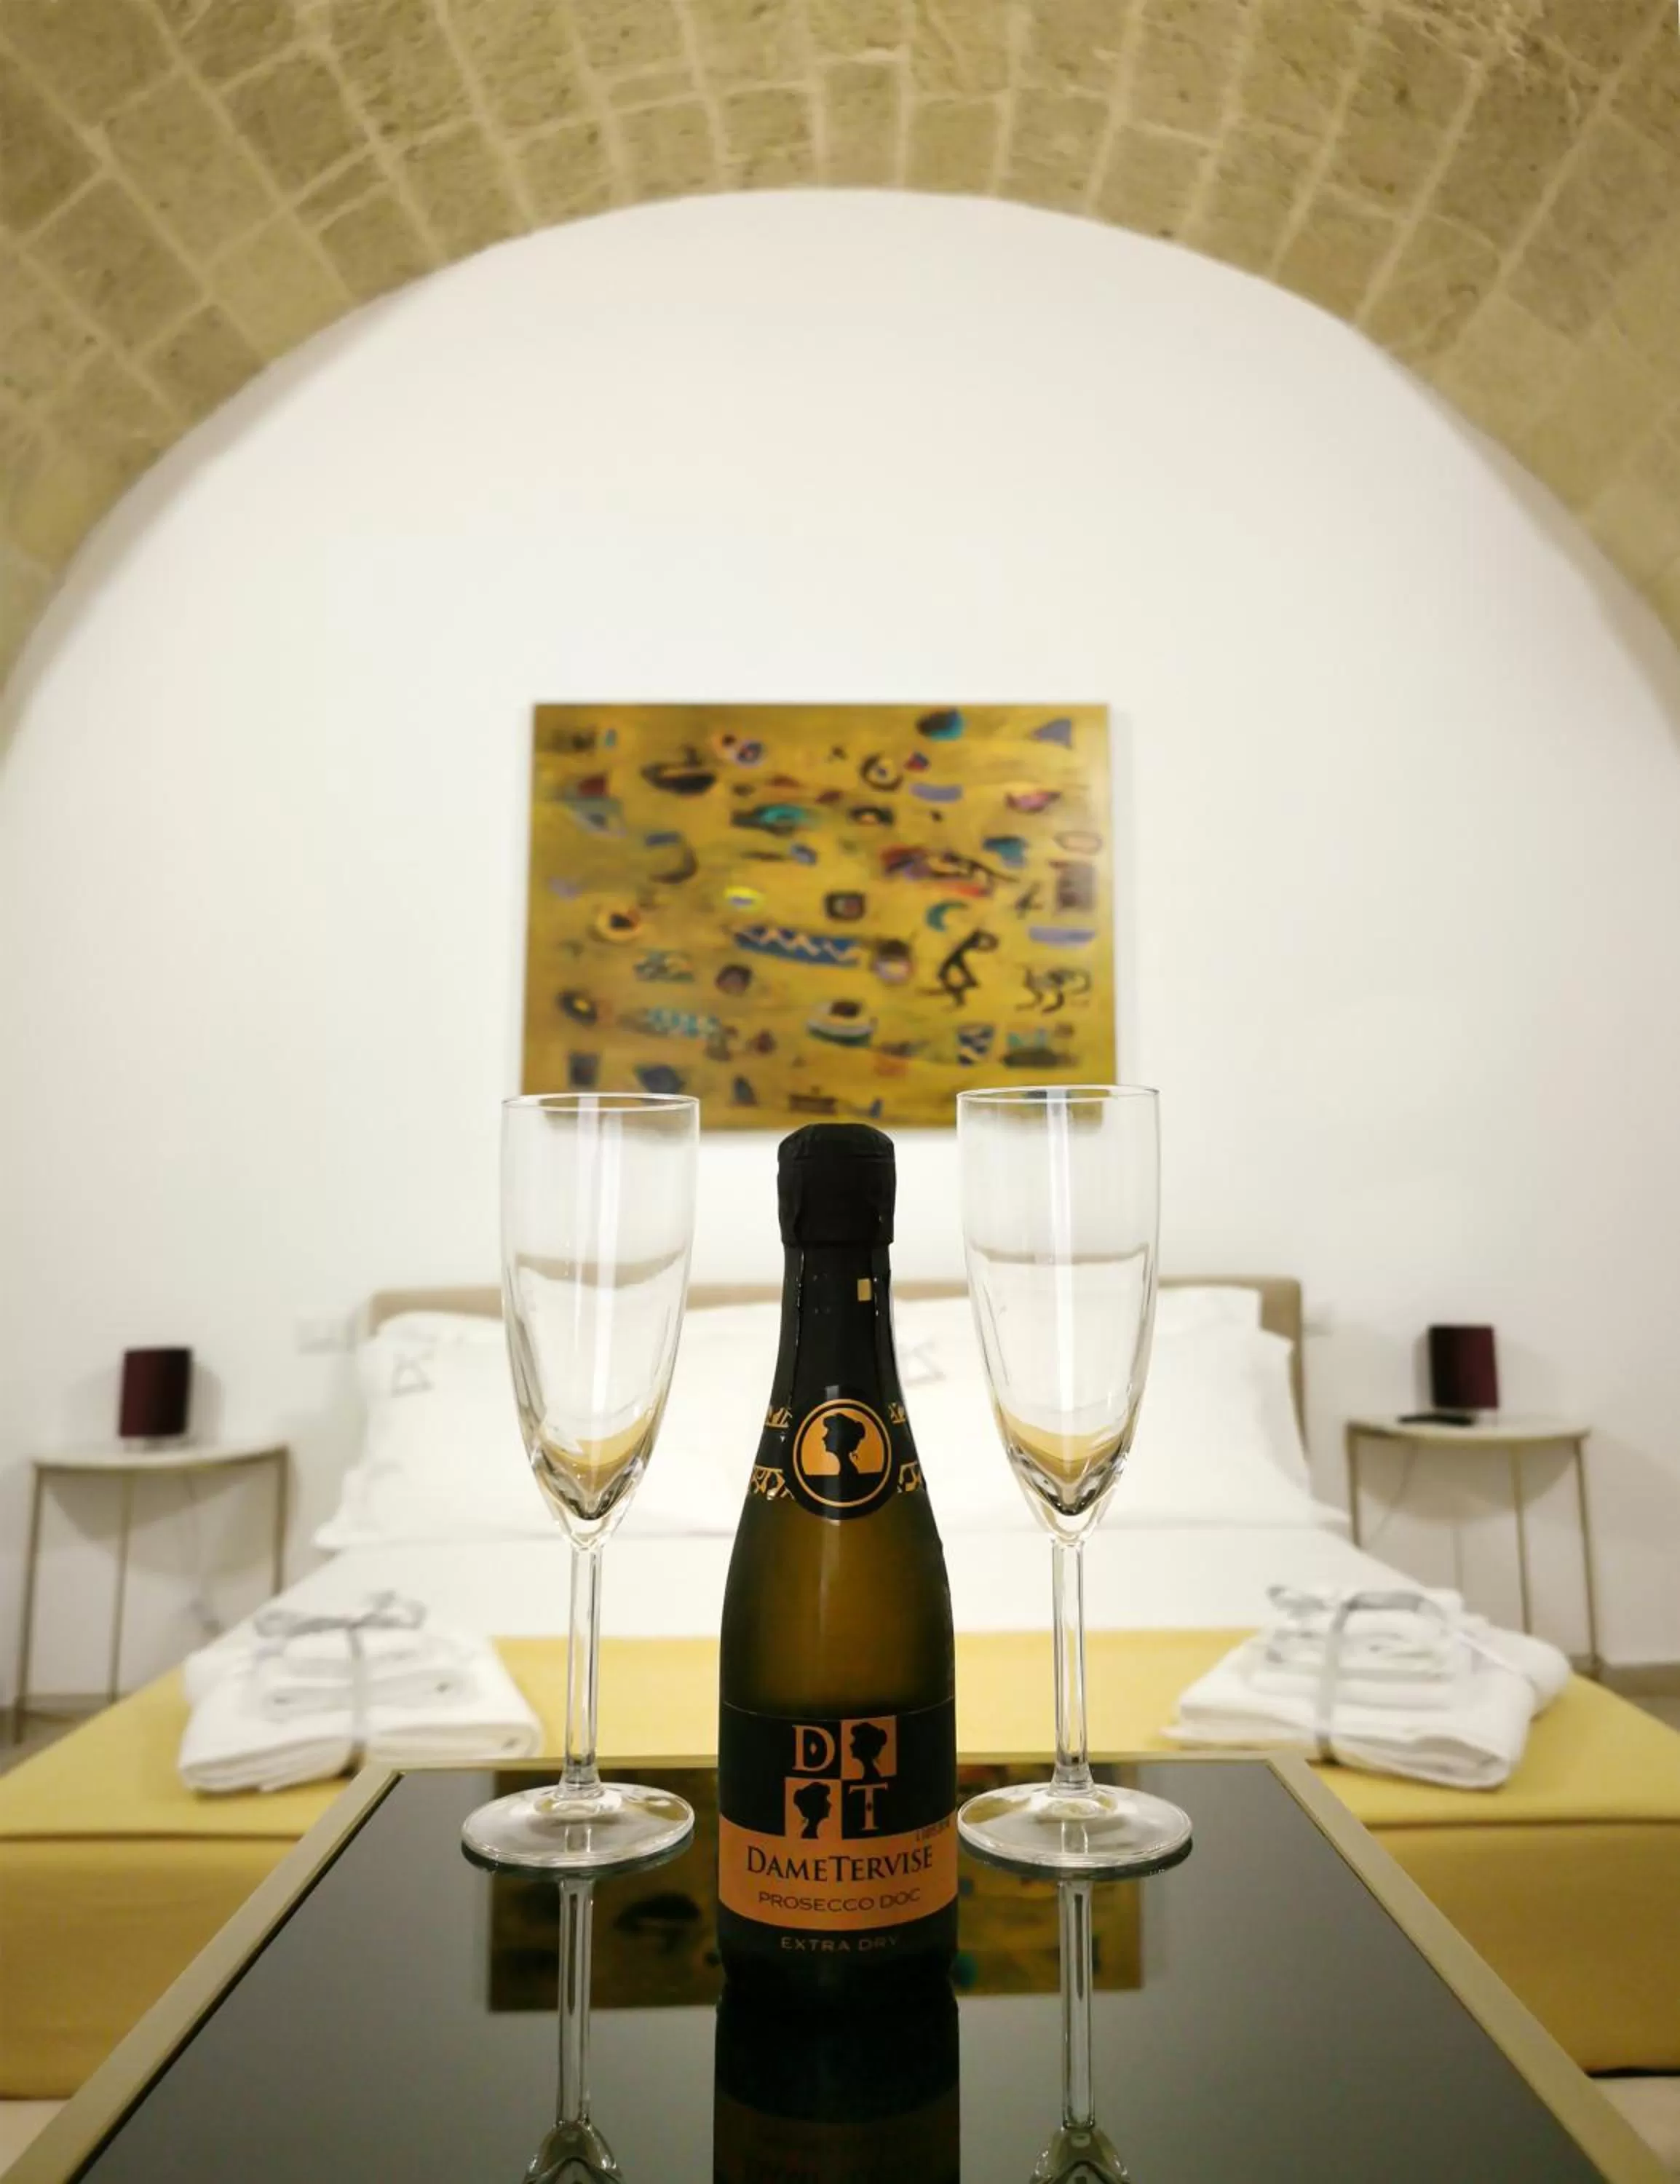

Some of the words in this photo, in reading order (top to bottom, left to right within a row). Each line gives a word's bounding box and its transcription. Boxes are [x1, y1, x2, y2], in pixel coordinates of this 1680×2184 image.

[792, 1725, 836, 1773] D
[848, 1782, 888, 1830] T
[758, 1891, 874, 1912] PROSECCO
[879, 1888, 921, 1909] DOC
[781, 1936, 850, 1952] EXTRA
[858, 1936, 898, 1951] DRY
